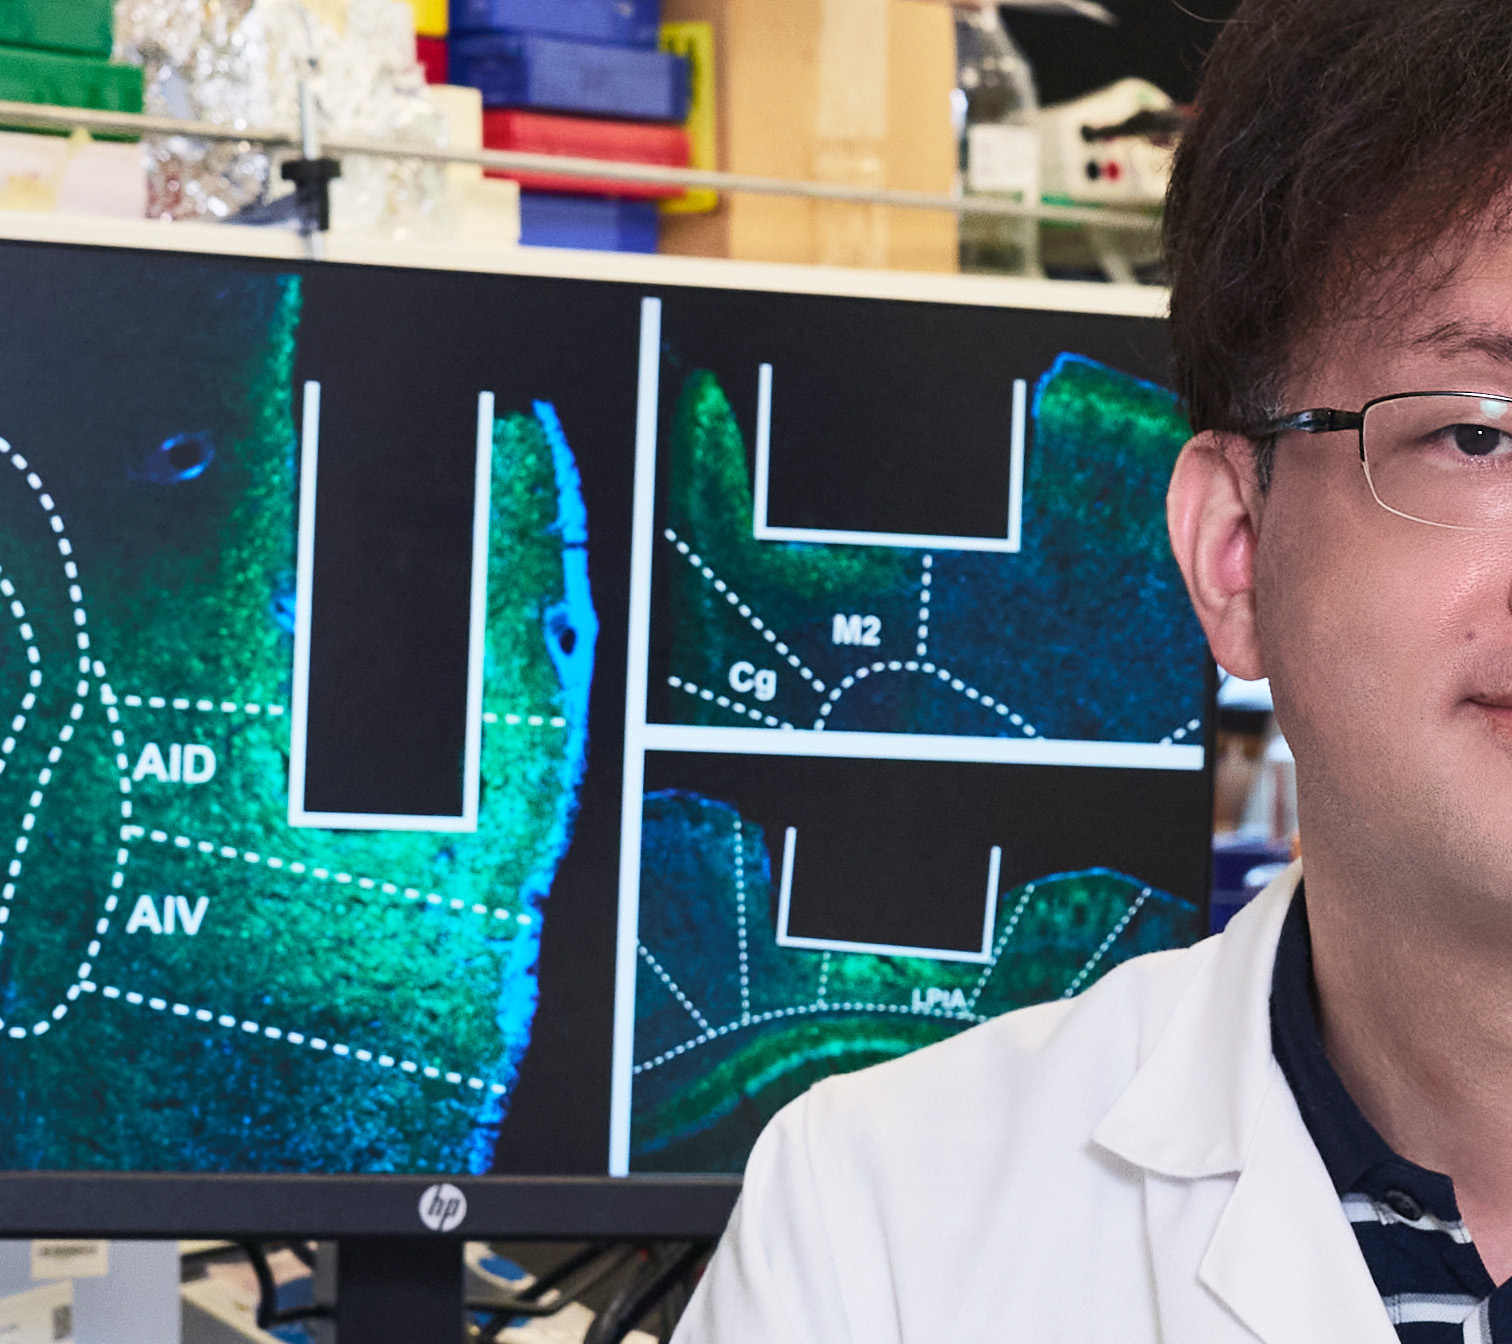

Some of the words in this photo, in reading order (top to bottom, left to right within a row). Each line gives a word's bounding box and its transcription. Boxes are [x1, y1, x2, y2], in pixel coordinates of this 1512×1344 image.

[832, 613, 882, 647] M2
[728, 661, 778, 702] Cg
[132, 742, 217, 784] AID
[125, 894, 210, 936] AIV
[426, 1183, 462, 1233] hp
